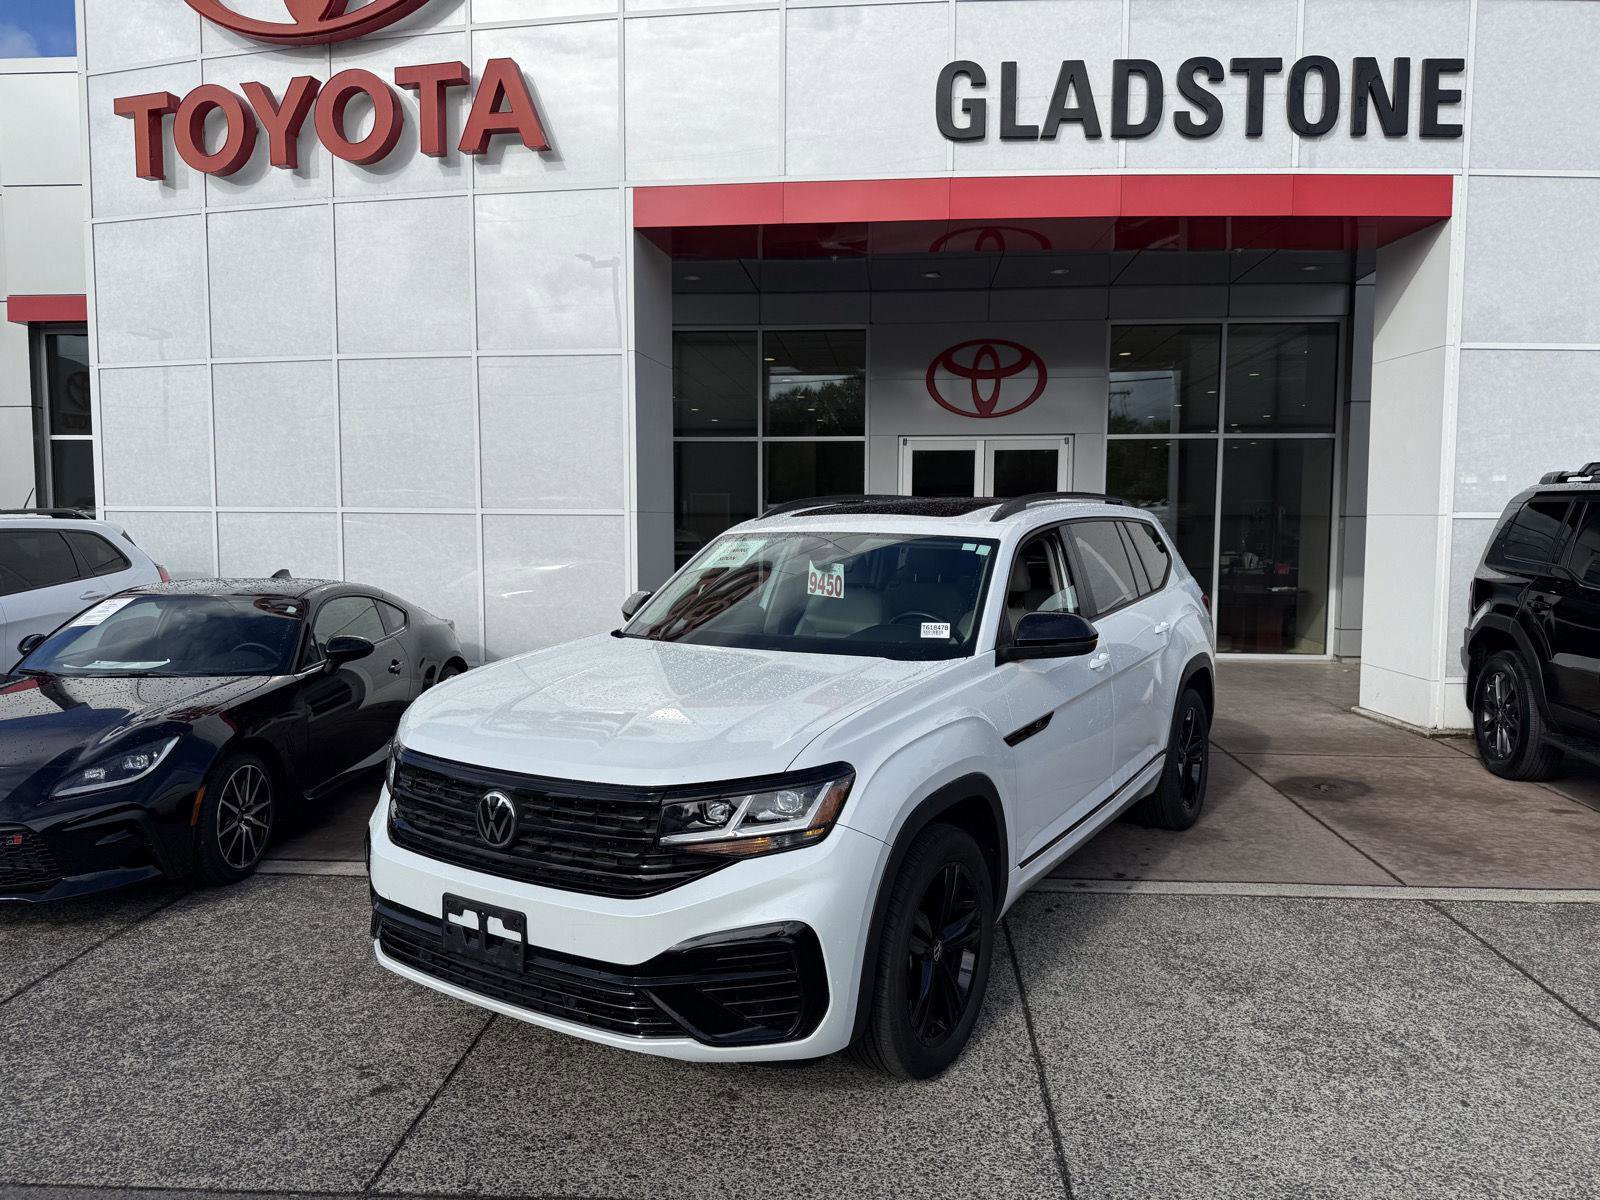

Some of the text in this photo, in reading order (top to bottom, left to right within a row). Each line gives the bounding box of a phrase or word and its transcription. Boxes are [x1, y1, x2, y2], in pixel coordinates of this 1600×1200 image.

[114, 57, 550, 181] TOYOTA
[935, 55, 1465, 141] GLADSTONE
[809, 571, 843, 598] 9450
